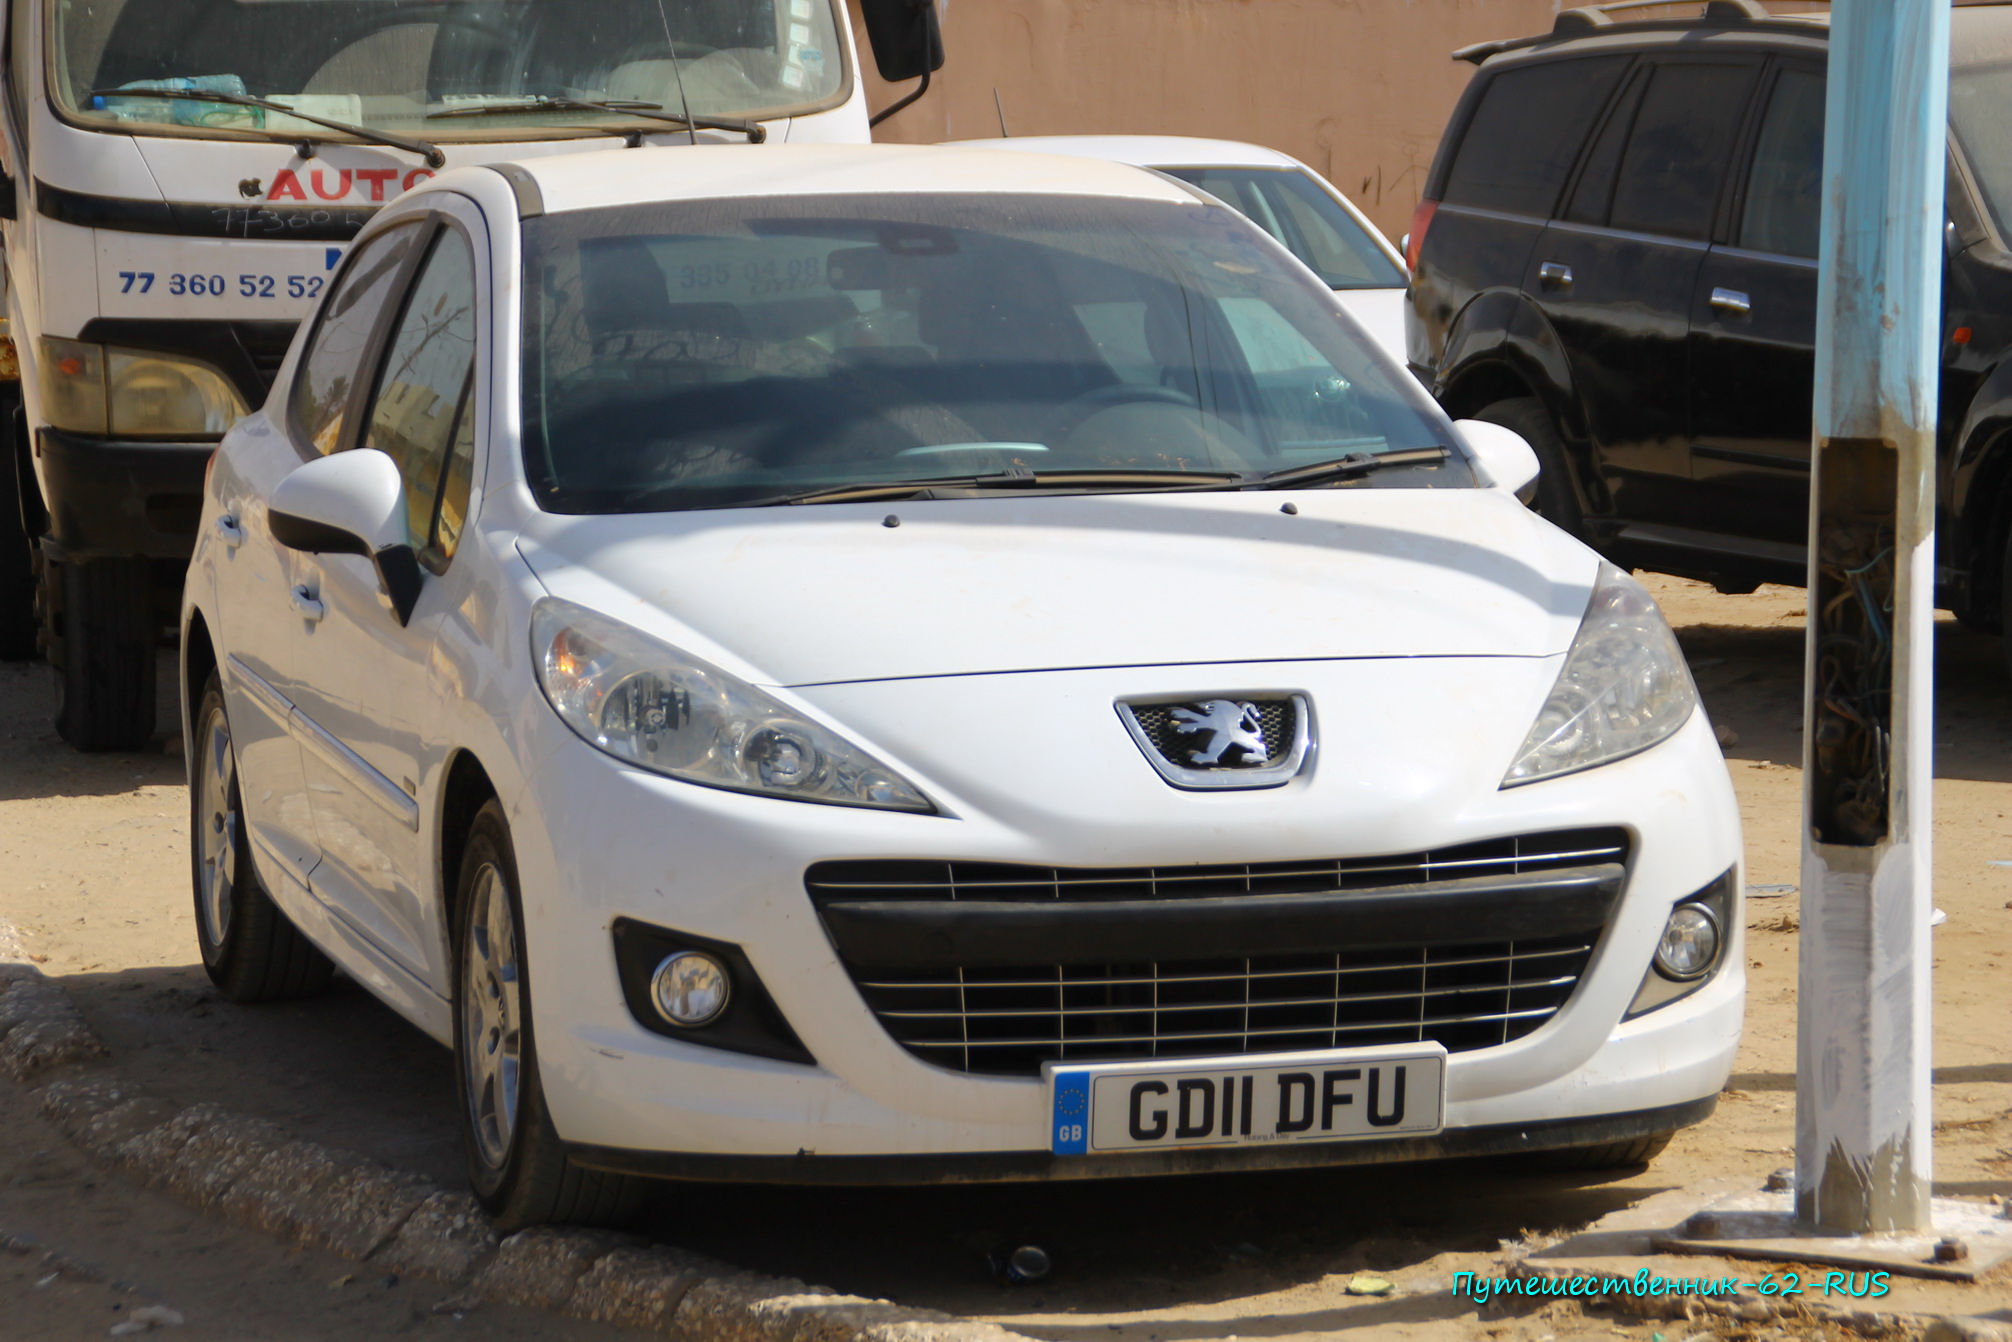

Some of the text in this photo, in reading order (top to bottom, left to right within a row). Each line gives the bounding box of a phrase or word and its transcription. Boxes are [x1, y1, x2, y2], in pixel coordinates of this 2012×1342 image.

[119, 271, 324, 298] 77 360 52 52
[1276, 1066, 1406, 1134] DFU
[1059, 1125, 1082, 1142] GB
